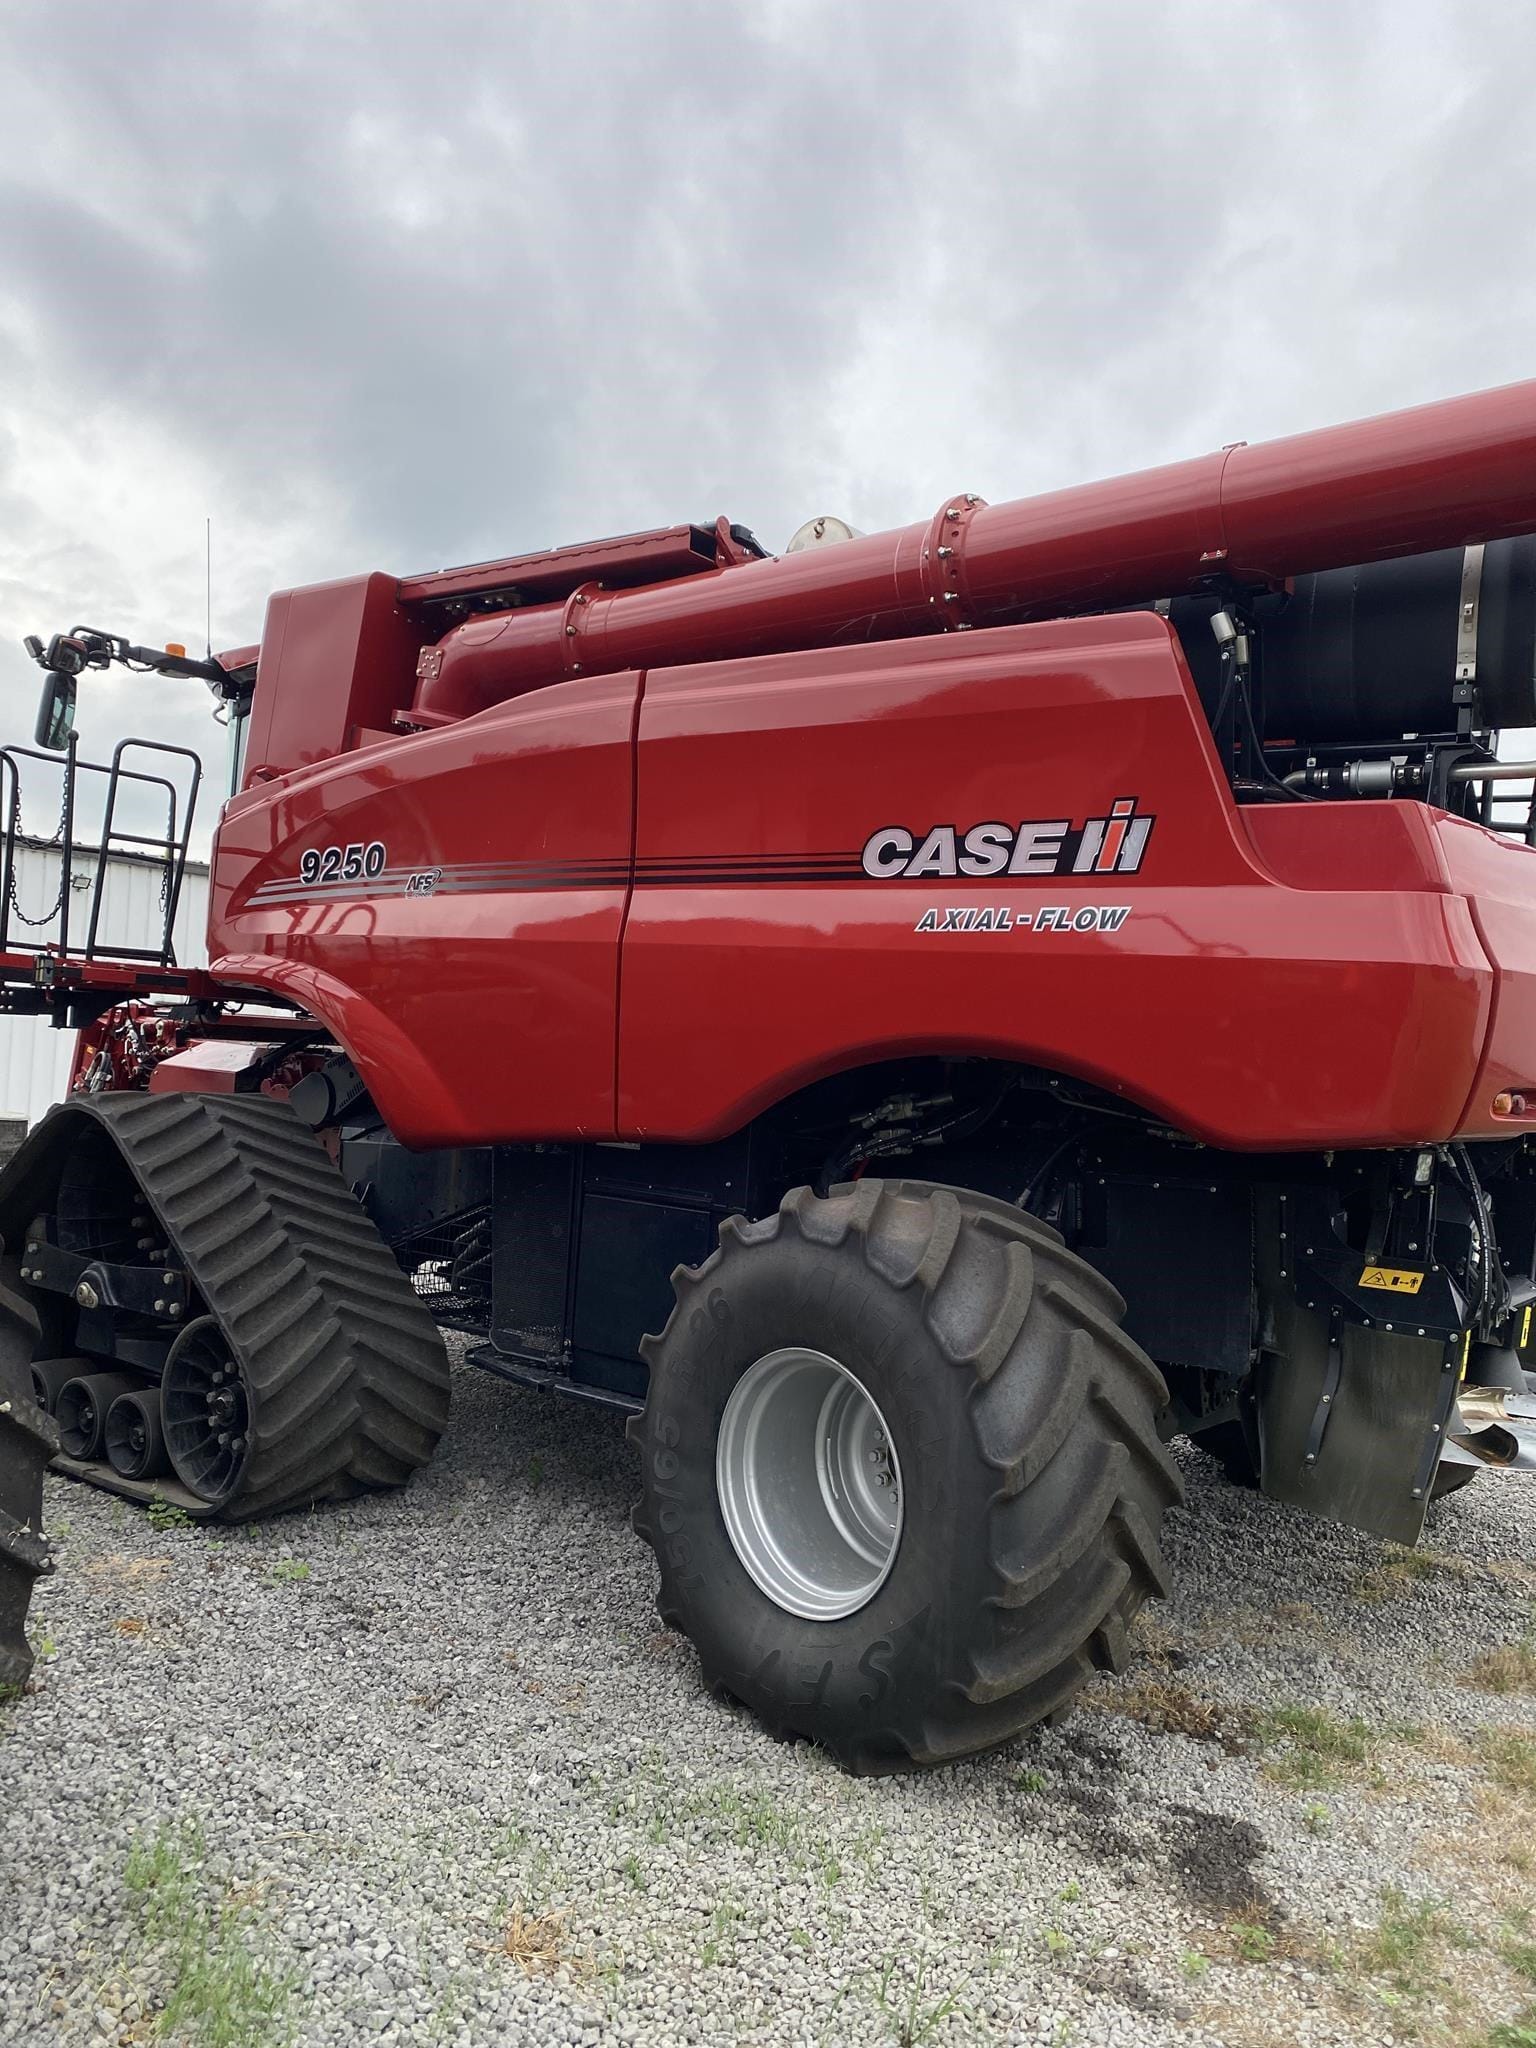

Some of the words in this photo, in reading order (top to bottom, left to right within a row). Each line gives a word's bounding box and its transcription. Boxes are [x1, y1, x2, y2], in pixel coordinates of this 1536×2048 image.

[301, 841, 386, 884] 9250
[862, 821, 1069, 878] CASE
[406, 872, 434, 892] AFS
[914, 906, 1132, 931] AXIAL-FLOW
[689, 1287, 731, 1352] 26
